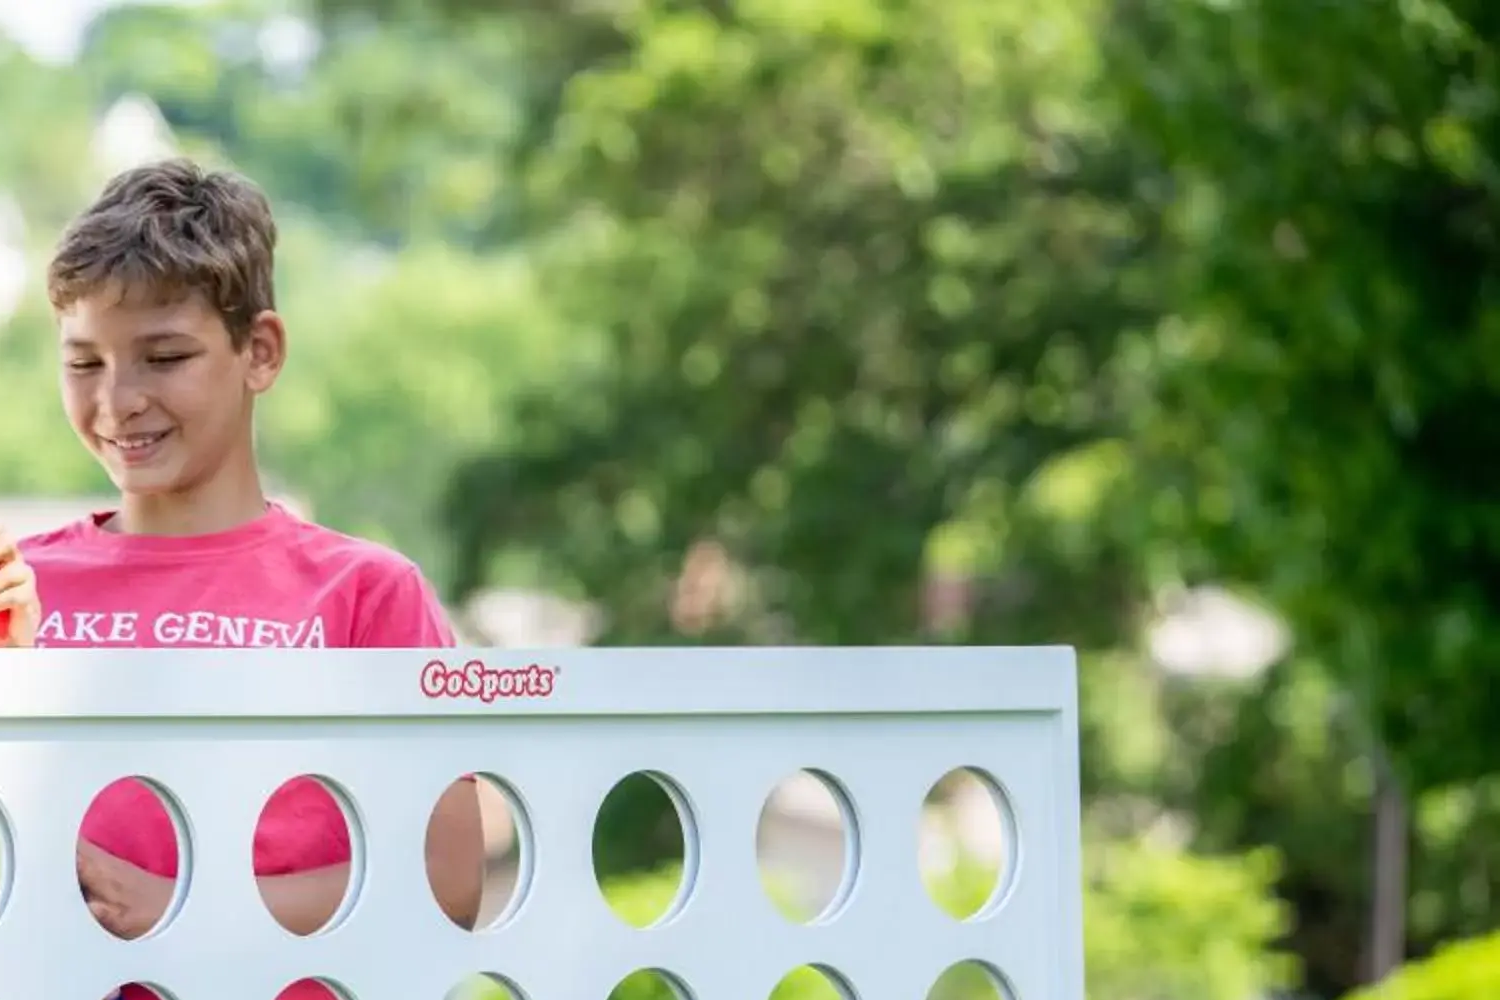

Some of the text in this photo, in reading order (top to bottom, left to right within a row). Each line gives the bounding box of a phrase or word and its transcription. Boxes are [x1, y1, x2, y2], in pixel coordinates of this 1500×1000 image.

[36, 610, 325, 648] AKE GENEVA
[421, 660, 553, 702] GoSports
